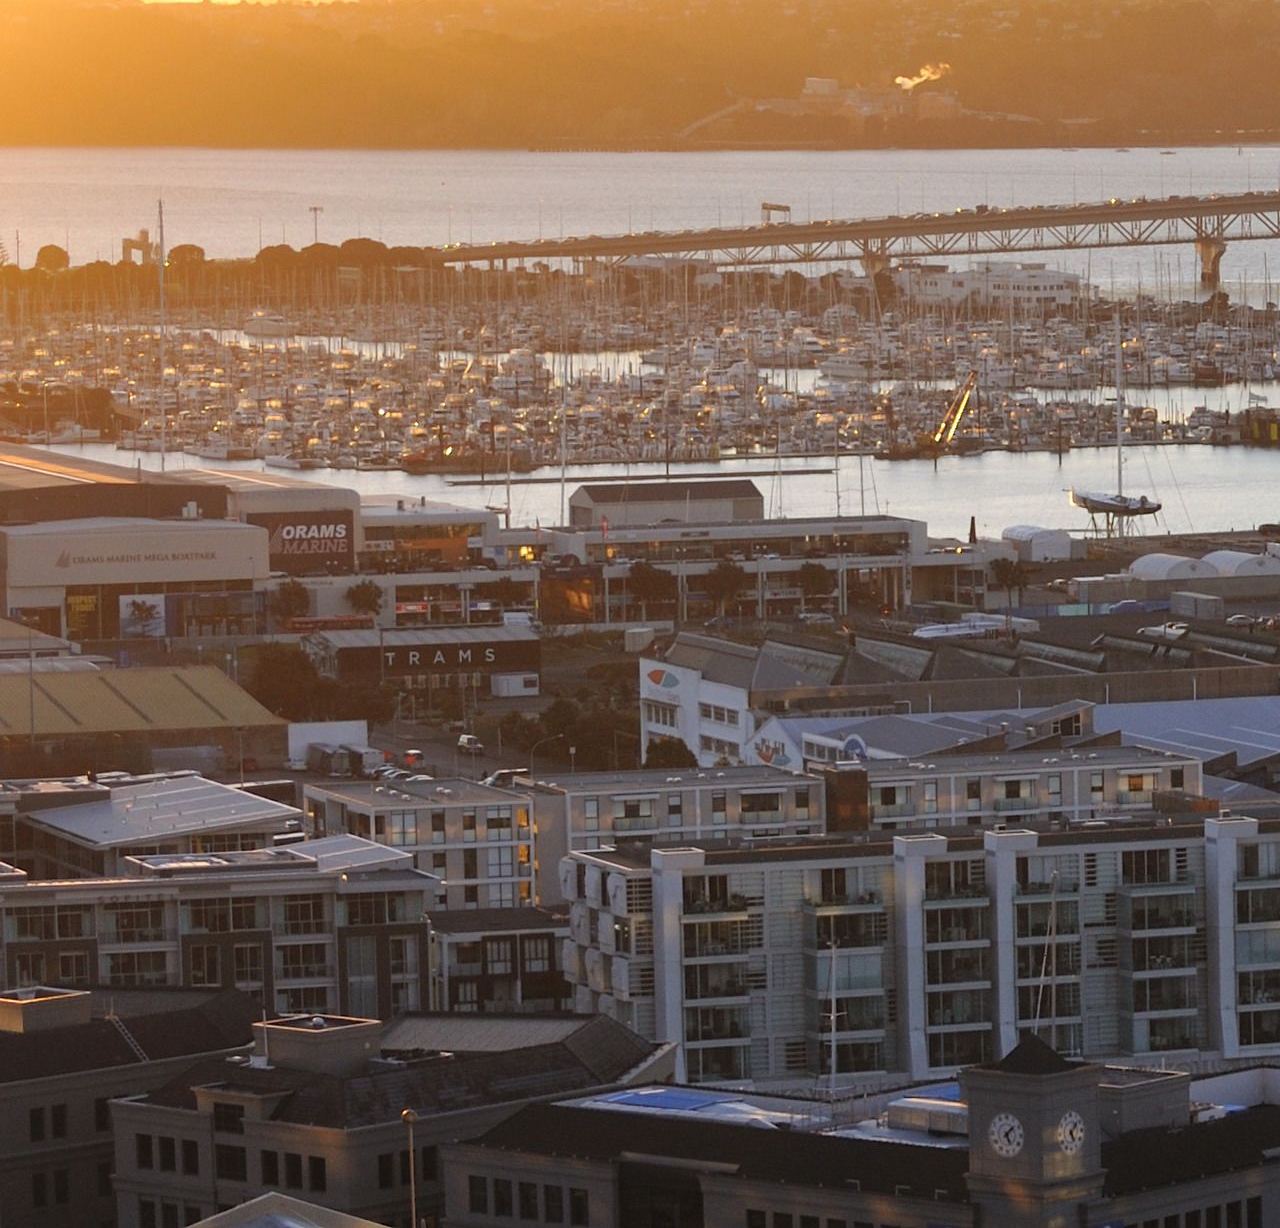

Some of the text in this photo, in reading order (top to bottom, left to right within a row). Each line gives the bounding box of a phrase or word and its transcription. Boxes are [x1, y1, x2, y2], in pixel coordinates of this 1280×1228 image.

[282, 524, 347, 539] ORAMS
[283, 539, 348, 554] MARINE
[73, 555, 104, 565] ORAMS
[106, 554, 143, 563] MARINE
[384, 648, 496, 666] TRAMS
